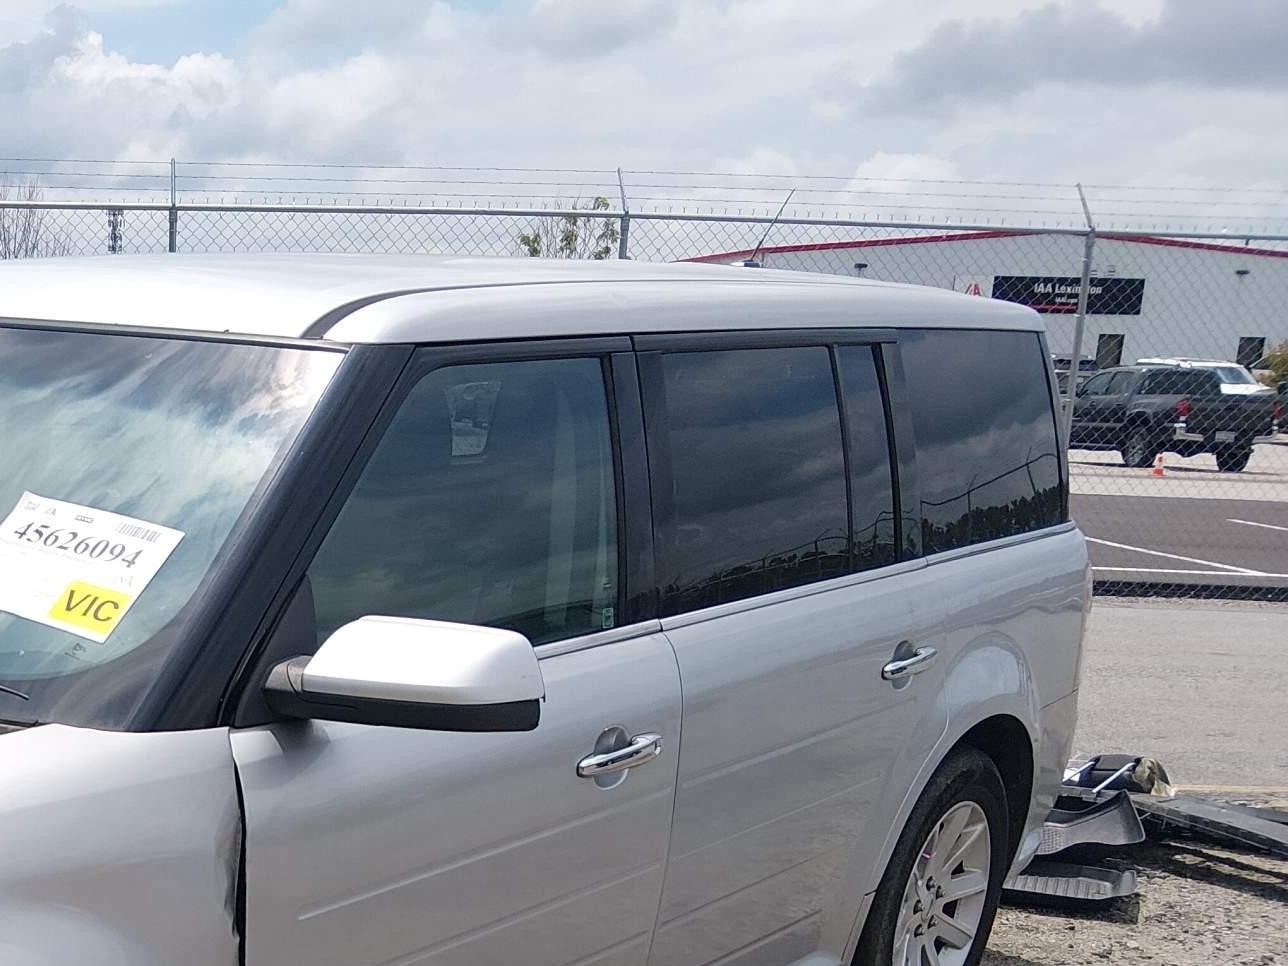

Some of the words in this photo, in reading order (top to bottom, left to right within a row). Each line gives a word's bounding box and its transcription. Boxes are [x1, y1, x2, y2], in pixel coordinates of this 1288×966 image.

[1033, 282, 1053, 294] IAA
[1055, 283, 1103, 295] Lexinon
[14, 521, 144, 569] 45626094
[64, 589, 120, 622] VIC
